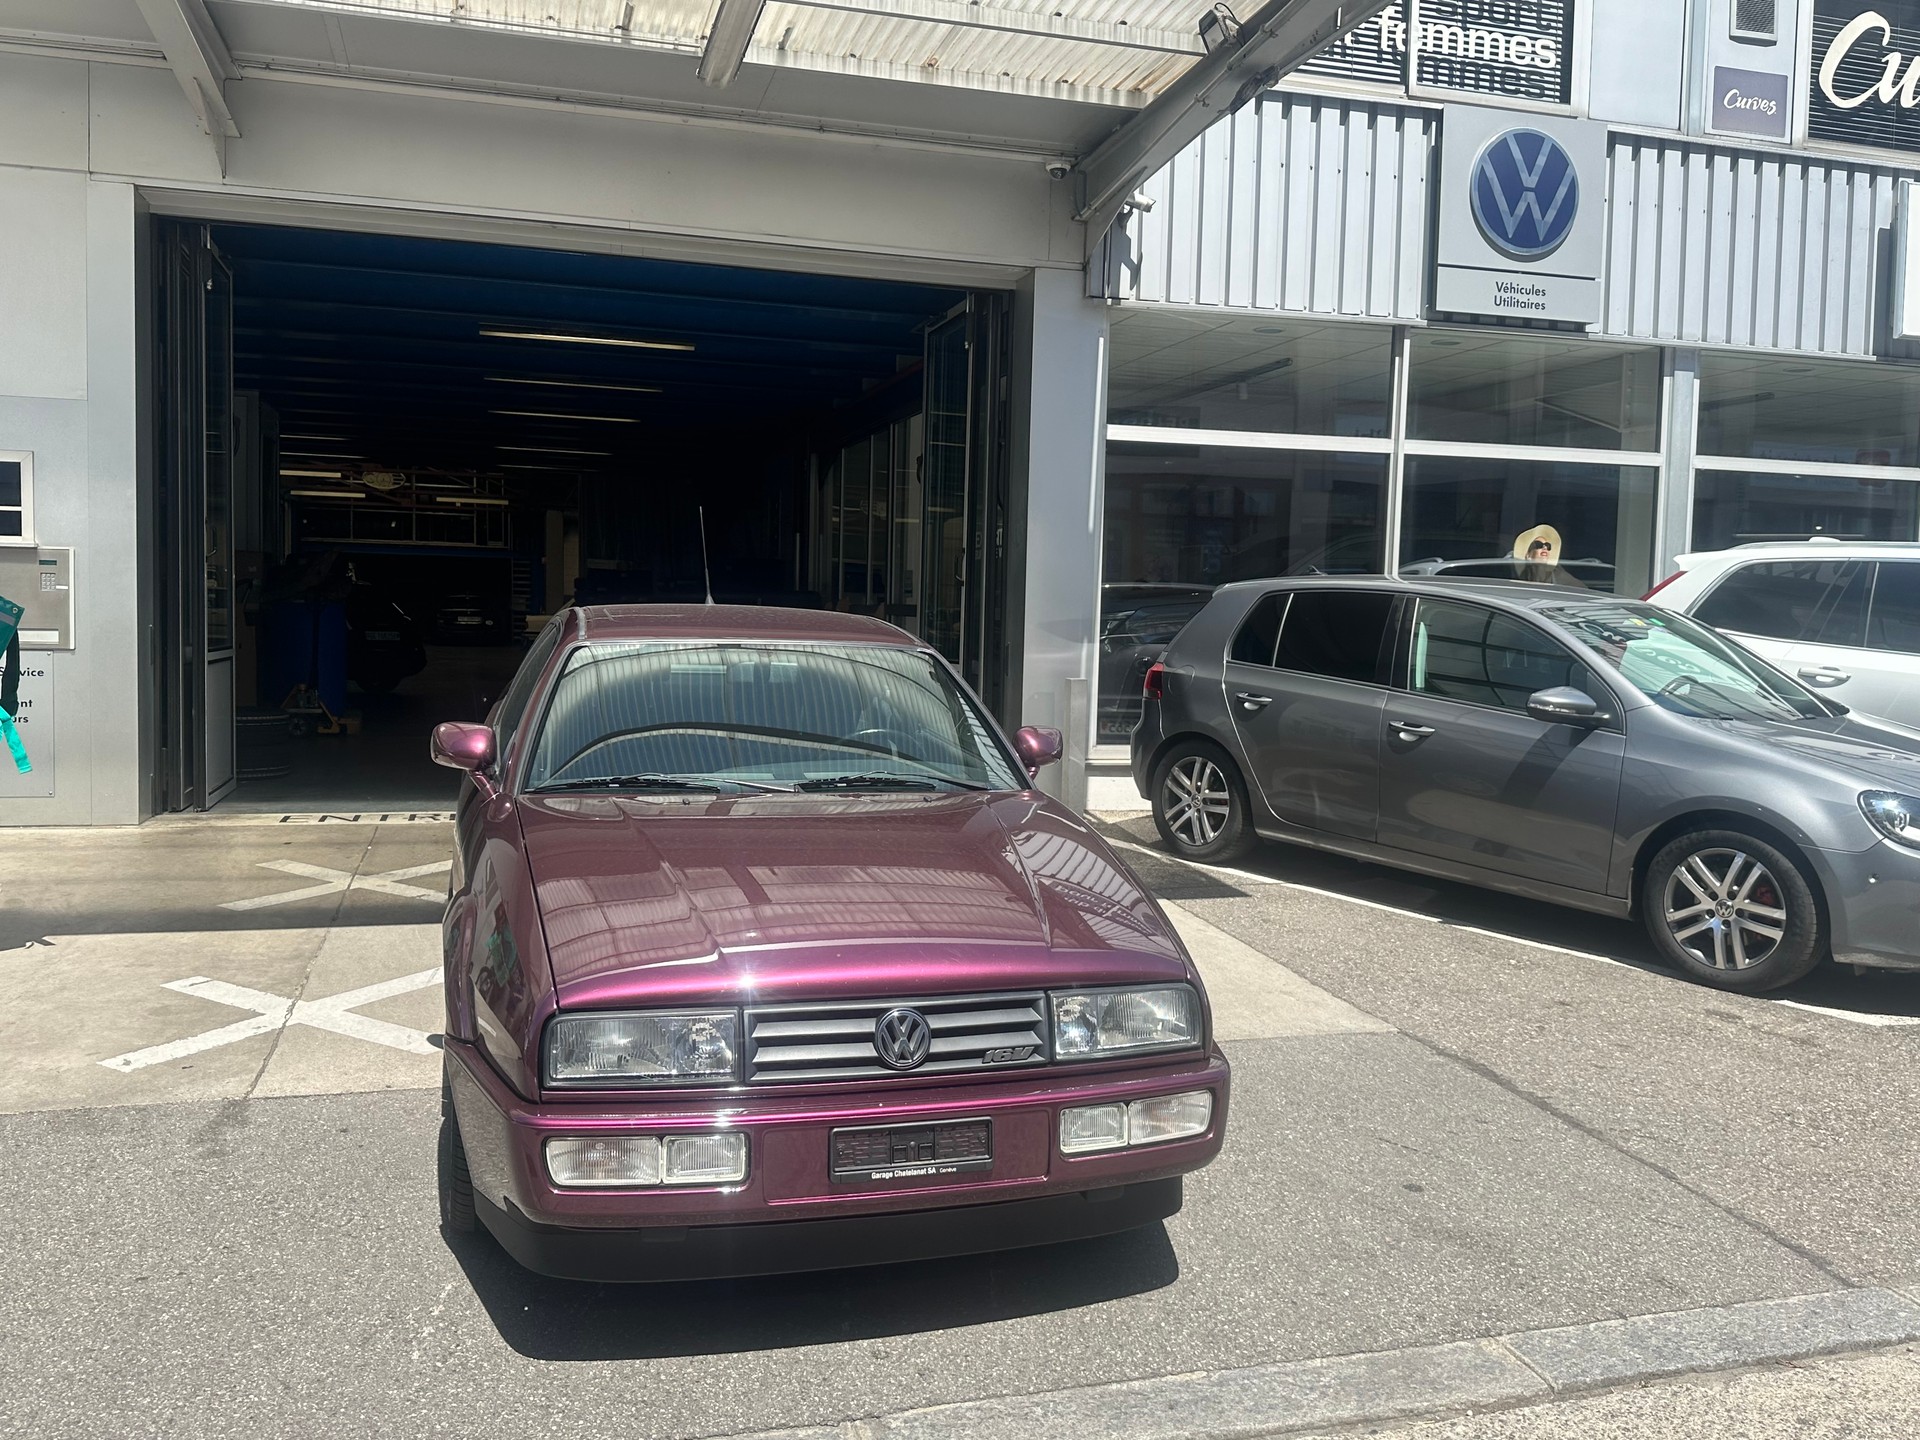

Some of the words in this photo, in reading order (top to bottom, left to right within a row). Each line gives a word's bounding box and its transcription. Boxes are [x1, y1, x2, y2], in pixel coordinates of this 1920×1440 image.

[1723, 88, 1777, 115] Curves
[1495, 281, 1547, 297] Véhicules
[1494, 295, 1546, 311] Utilitaires
[0, 666, 45, 677] Svice
[981, 1046, 1035, 1064] 16V
[871, 1171, 893, 1180] Garage
[927, 1166, 937, 1175] SA
